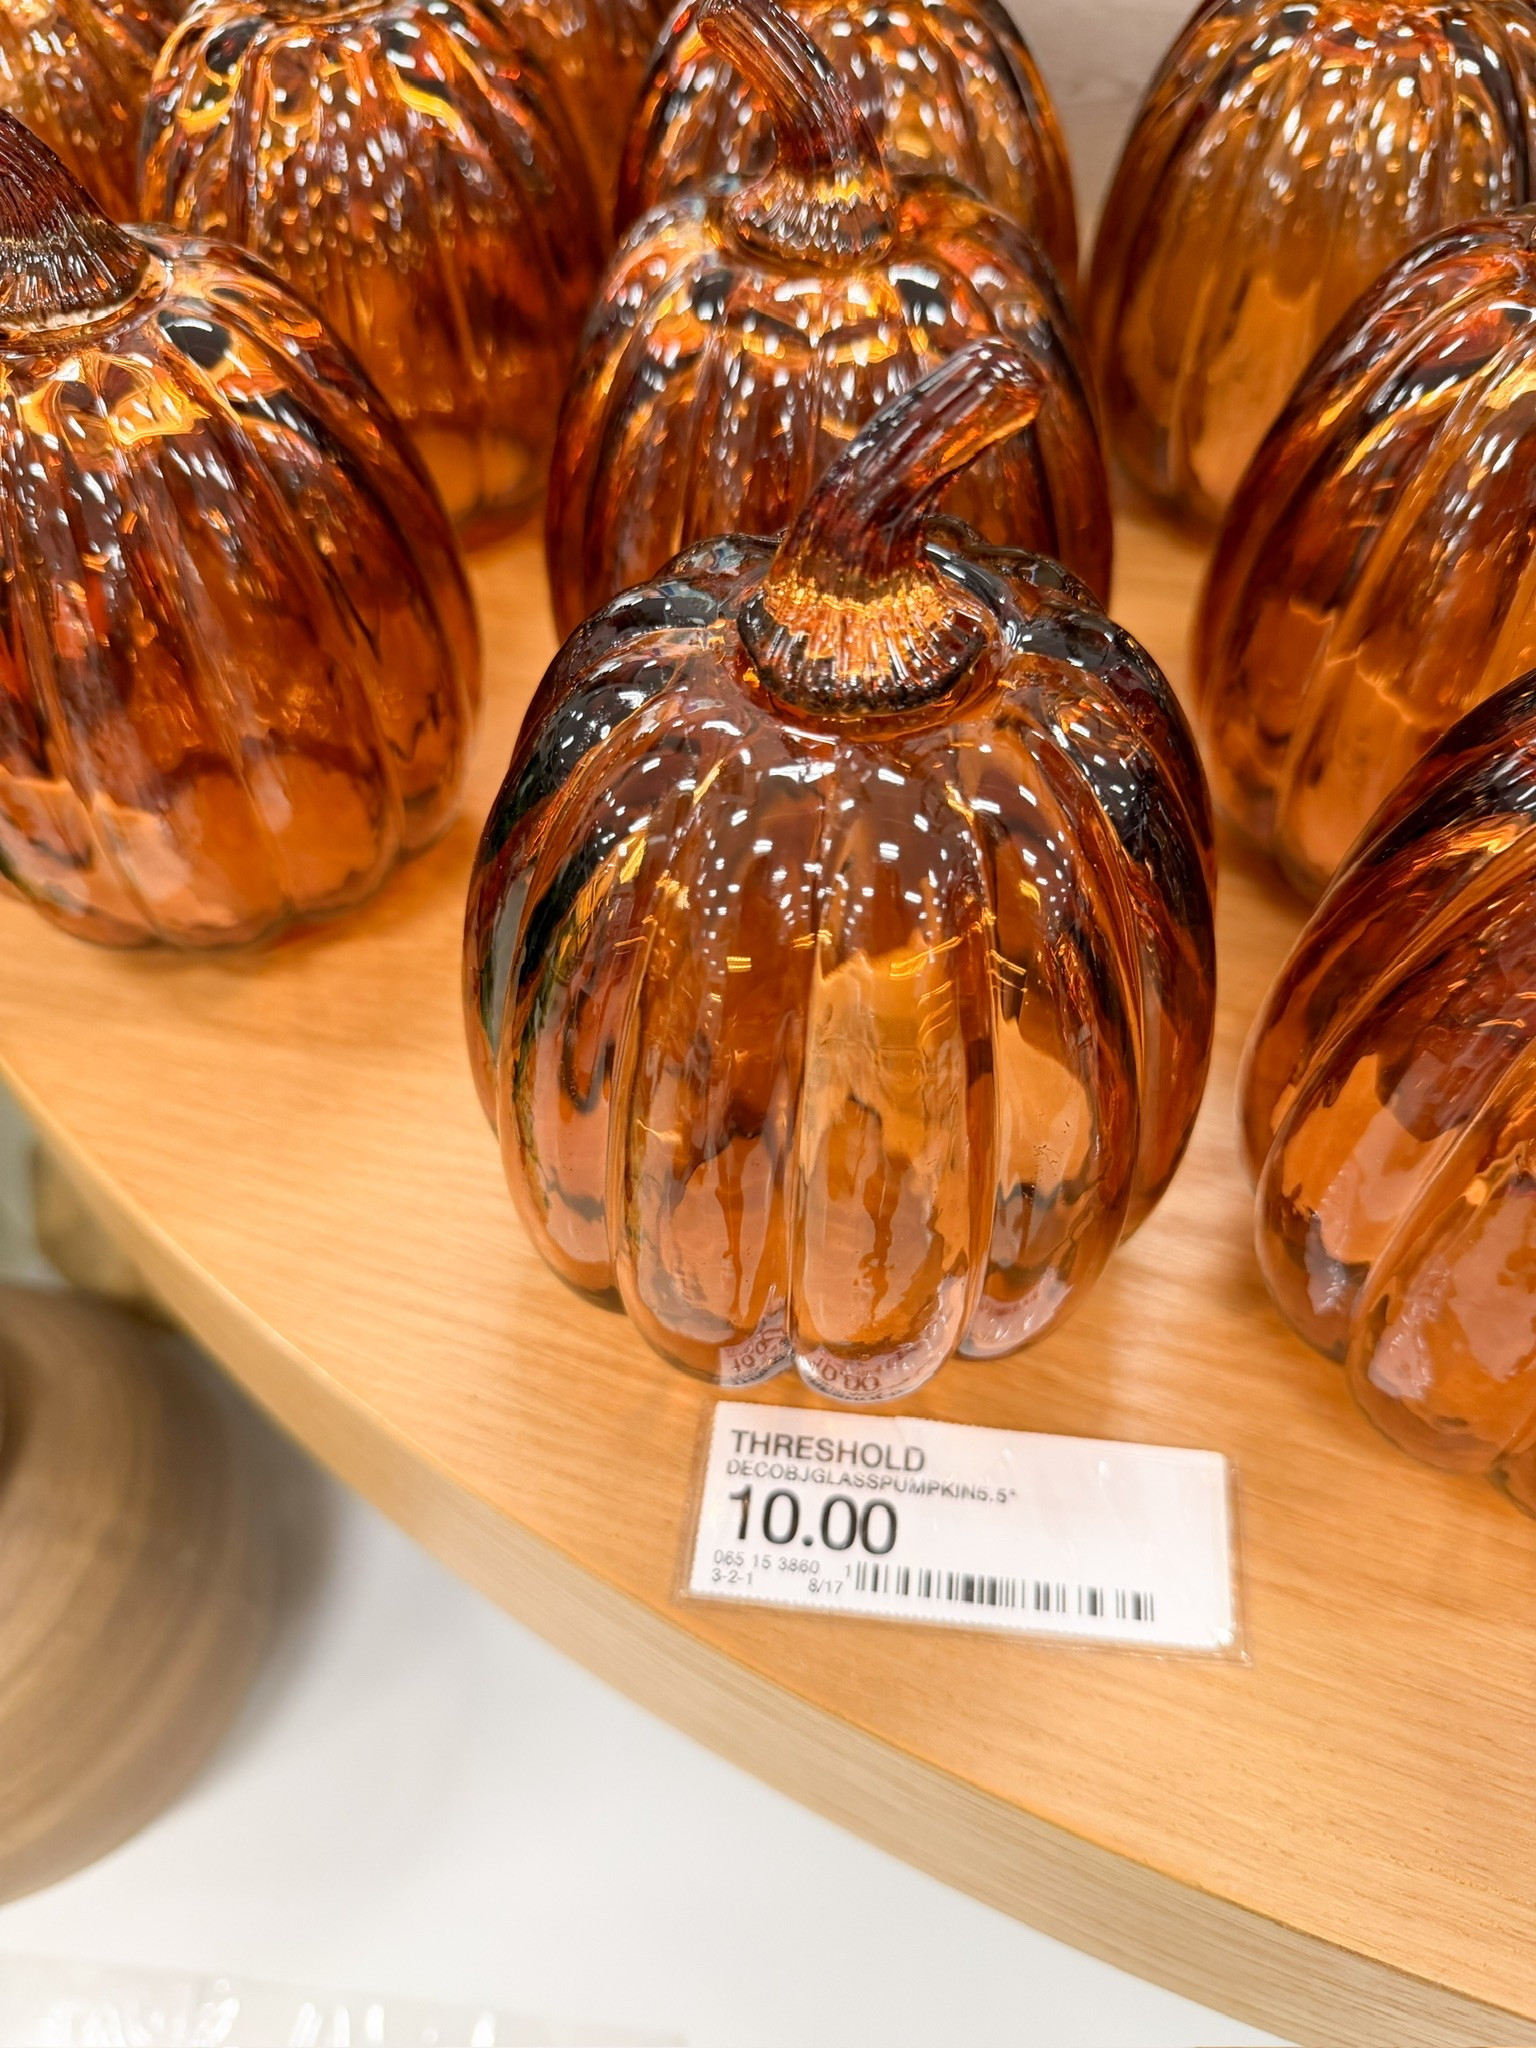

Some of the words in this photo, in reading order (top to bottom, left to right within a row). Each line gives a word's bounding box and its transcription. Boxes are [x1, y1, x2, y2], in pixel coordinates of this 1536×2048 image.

[731, 1429, 926, 1472] THRESHOLD
[729, 1484, 898, 1556] 10.00
[713, 1549, 745, 1566] 065
[753, 1553, 772, 1569] 15
[778, 1556, 821, 1575] 3860
[711, 1567, 754, 1585] 3-2-1
[808, 1577, 844, 1595] 8/17
